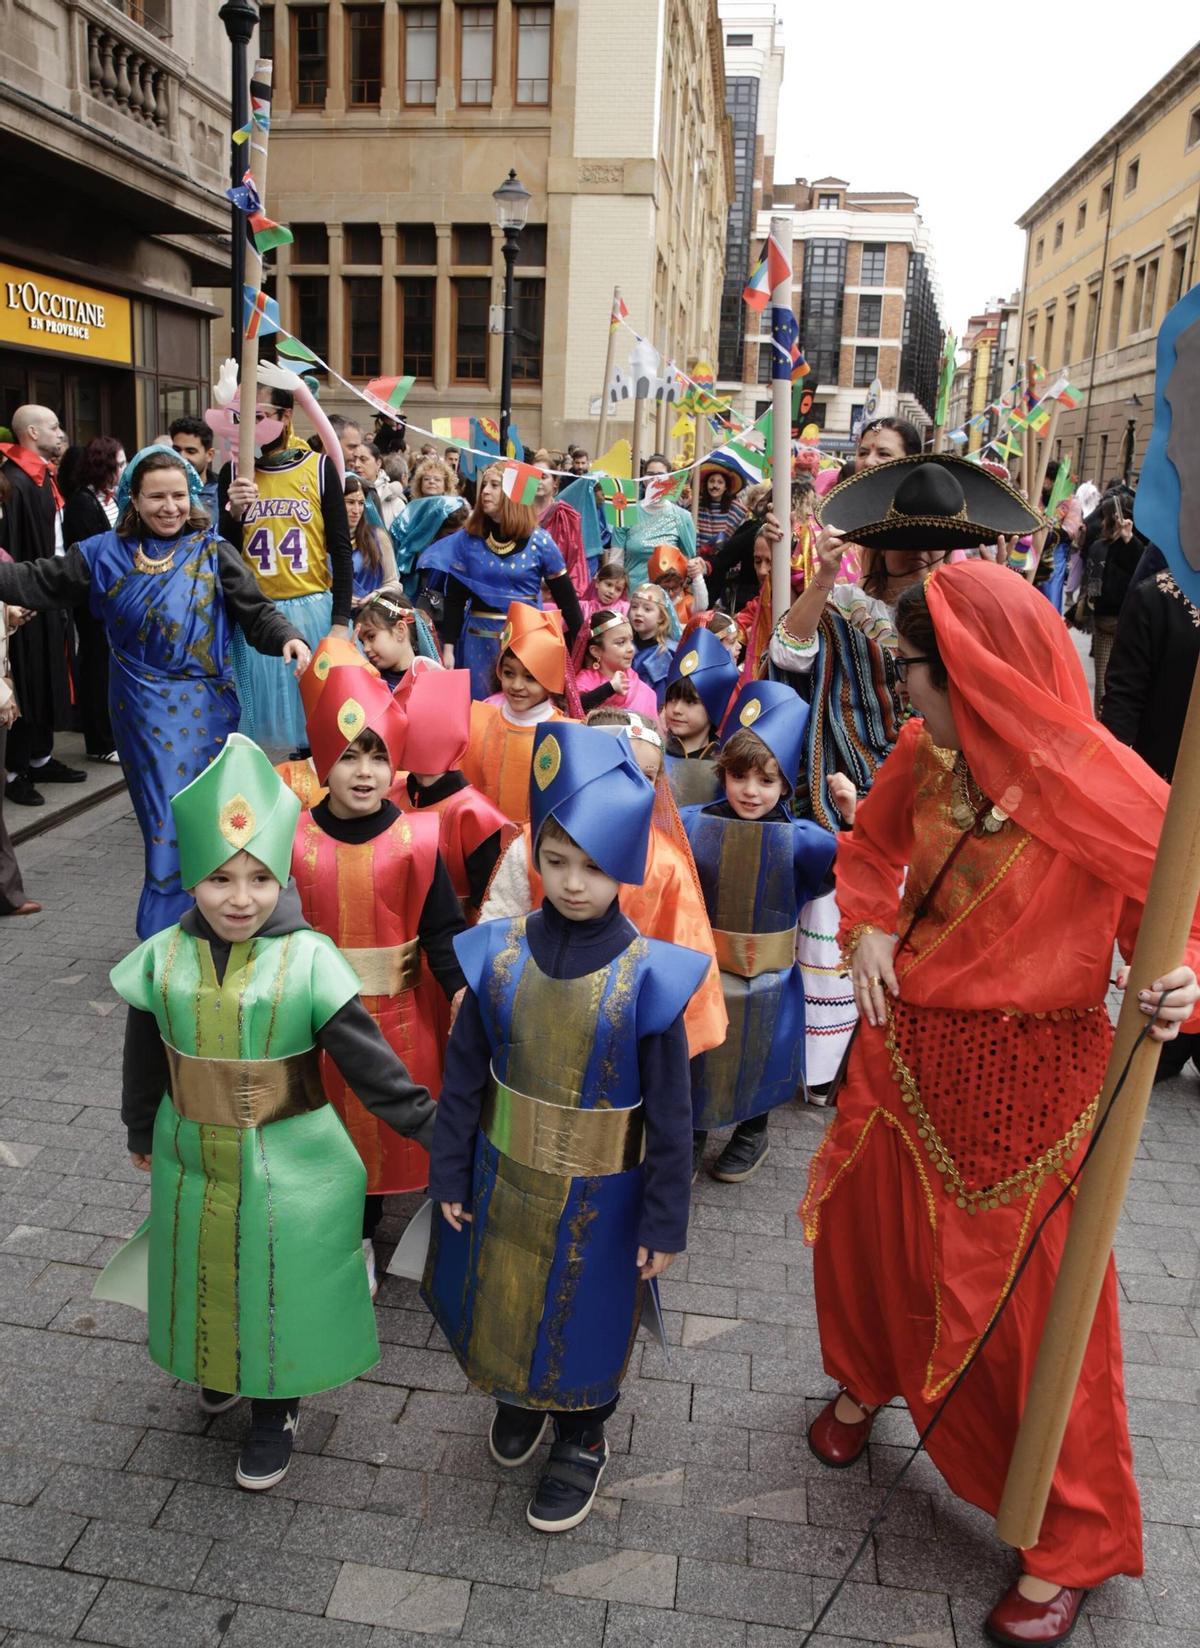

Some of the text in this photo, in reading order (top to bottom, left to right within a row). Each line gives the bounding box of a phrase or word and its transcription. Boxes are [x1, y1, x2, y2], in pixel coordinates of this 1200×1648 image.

[30, 316, 90, 340] EN PROVENCE
[243, 498, 313, 525] LAKERS
[247, 526, 310, 576] 44
